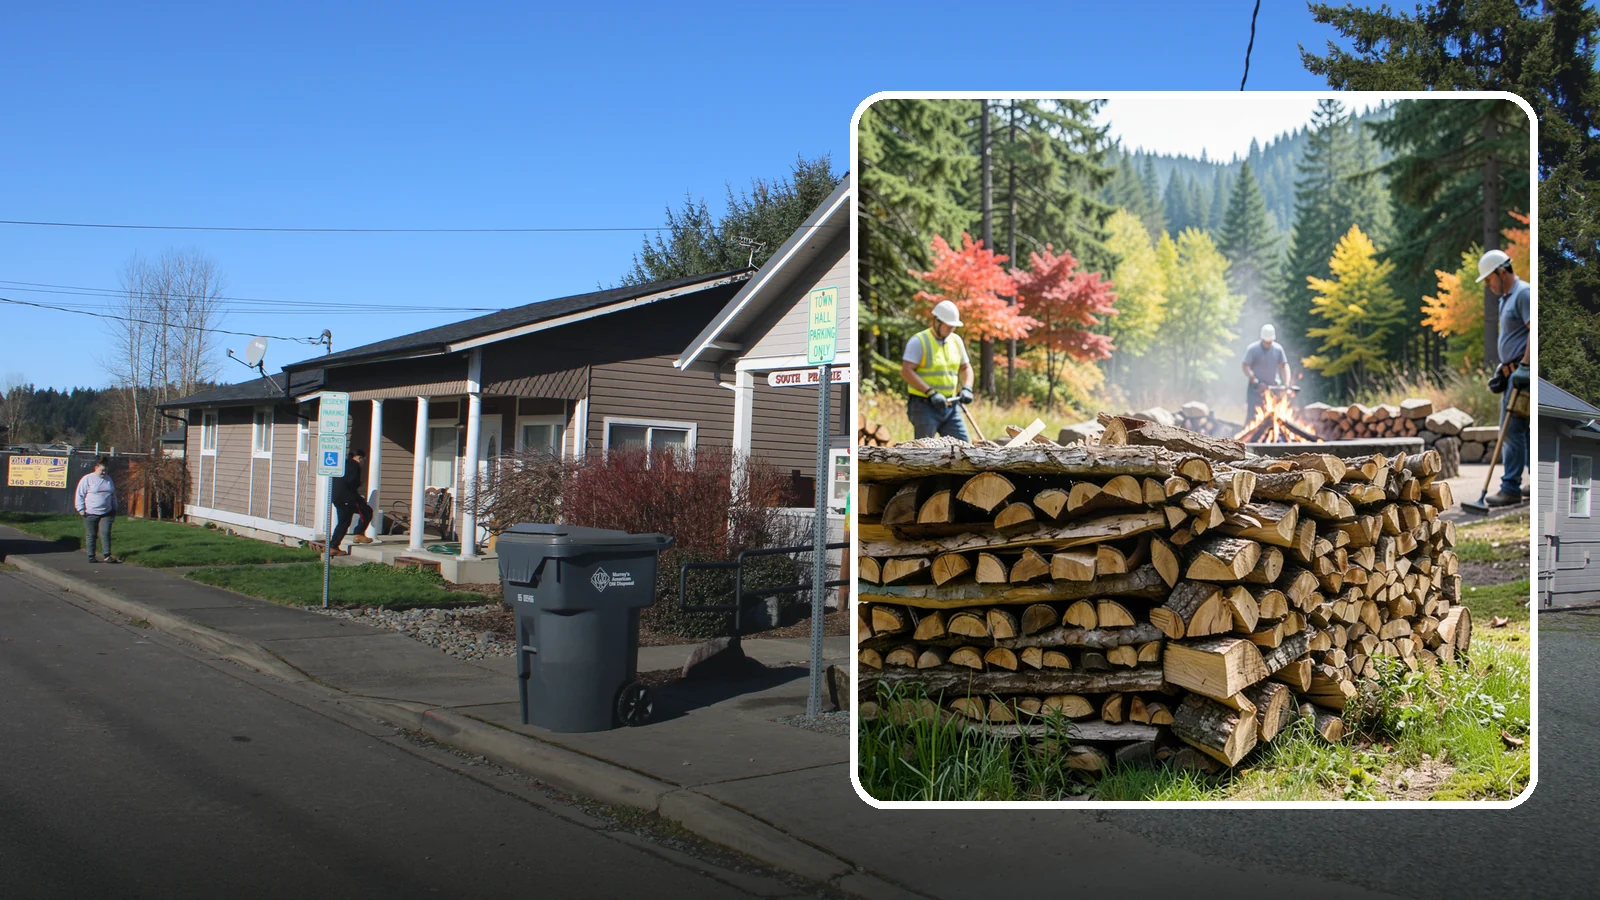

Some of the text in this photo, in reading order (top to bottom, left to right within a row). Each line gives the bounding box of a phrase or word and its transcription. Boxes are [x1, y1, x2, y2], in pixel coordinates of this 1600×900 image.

[815, 295, 833, 307] TOWN
[815, 312, 831, 324] HALL
[810, 327, 836, 340] PARKING
[814, 344, 831, 357] ONLY
[775, 373, 801, 384] SOUTH
